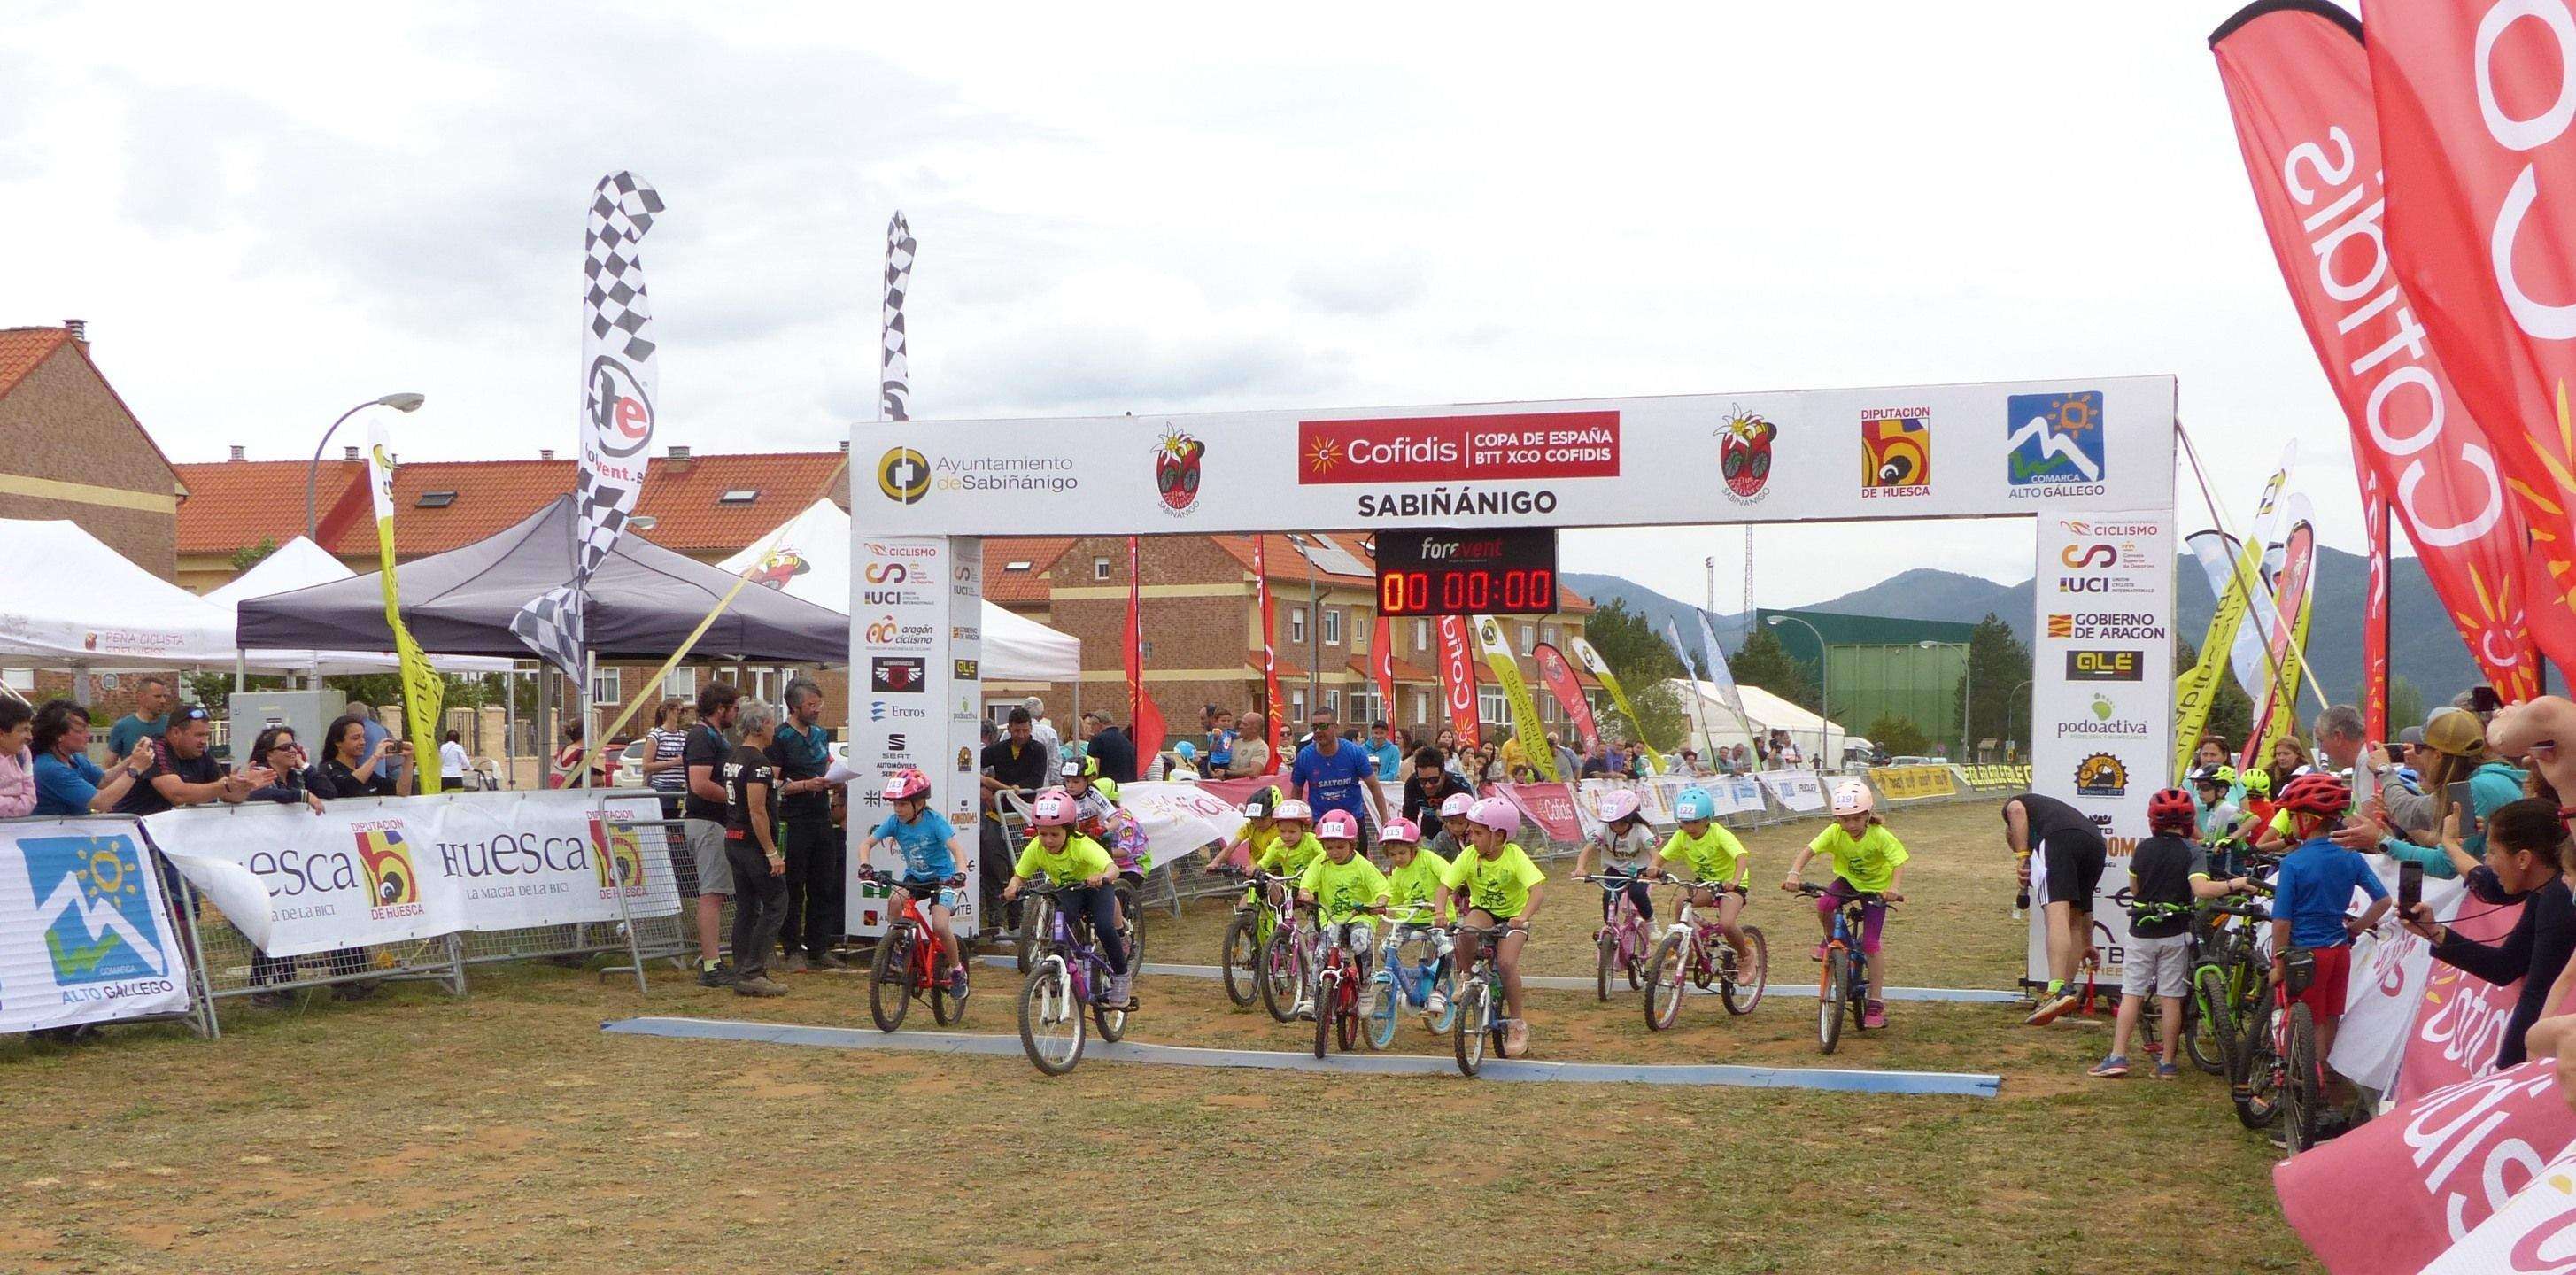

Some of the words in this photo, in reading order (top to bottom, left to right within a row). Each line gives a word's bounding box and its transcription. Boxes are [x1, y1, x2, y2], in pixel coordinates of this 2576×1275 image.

[1860, 406, 1930, 420] DIPUTACION
[1474, 433, 1519, 448] COPA
[1523, 432, 1544, 446] DE
[1549, 426, 1613, 445] ESPAÑA
[1347, 437, 1458, 465] Cofidis
[1475, 451, 1503, 465] BTT
[1507, 450, 1541, 464] XCO
[1545, 447, 1612, 462] COFIDIS
[936, 455, 1073, 473] Ayuntamiento
[2031, 474, 2080, 483] COMARCA
[1860, 488, 1878, 498] DE
[1882, 486, 1930, 498] HUESCA
[2008, 487, 2041, 498] ALTO
[2042, 484, 2106, 498] GÁLLEGO
[1358, 486, 1558, 518] SABIÑÁNIGO
[2093, 525, 2158, 536] CICLISMO
[889, 547, 936, 557] CICLISMO
[2069, 577, 2108, 593] UCI
[871, 591, 901, 605] UCI
[2075, 613, 2154, 626] GOBIERNO
[139, 633, 185, 645] CICLISTA
[895, 635, 932, 645] ciclismo
[2074, 627, 2094, 639] DE
[2100, 627, 2165, 639] ARAGON
[892, 705, 925, 718] Ercros
[2057, 718, 2147, 738] podoactiva
[1039, 802, 1056, 812] 118
[1543, 799, 1574, 823] Cofidis
[1679, 806, 1694, 815] 122
[350, 817, 404, 832] DIPUTACION
[1324, 823, 1342, 832] 114
[1385, 828, 1400, 837] 115
[244, 849, 359, 898] esca
[600, 889, 612, 900] DE
[613, 886, 647, 898] HESCA
[314, 904, 336, 917] BICI
[371, 908, 385, 921] DE
[386, 904, 424, 919] HUESCA
[99, 964, 135, 975] COMARCA
[61, 986, 102, 1006] ALTO
[103, 979, 174, 1000] GÁLLEGO
